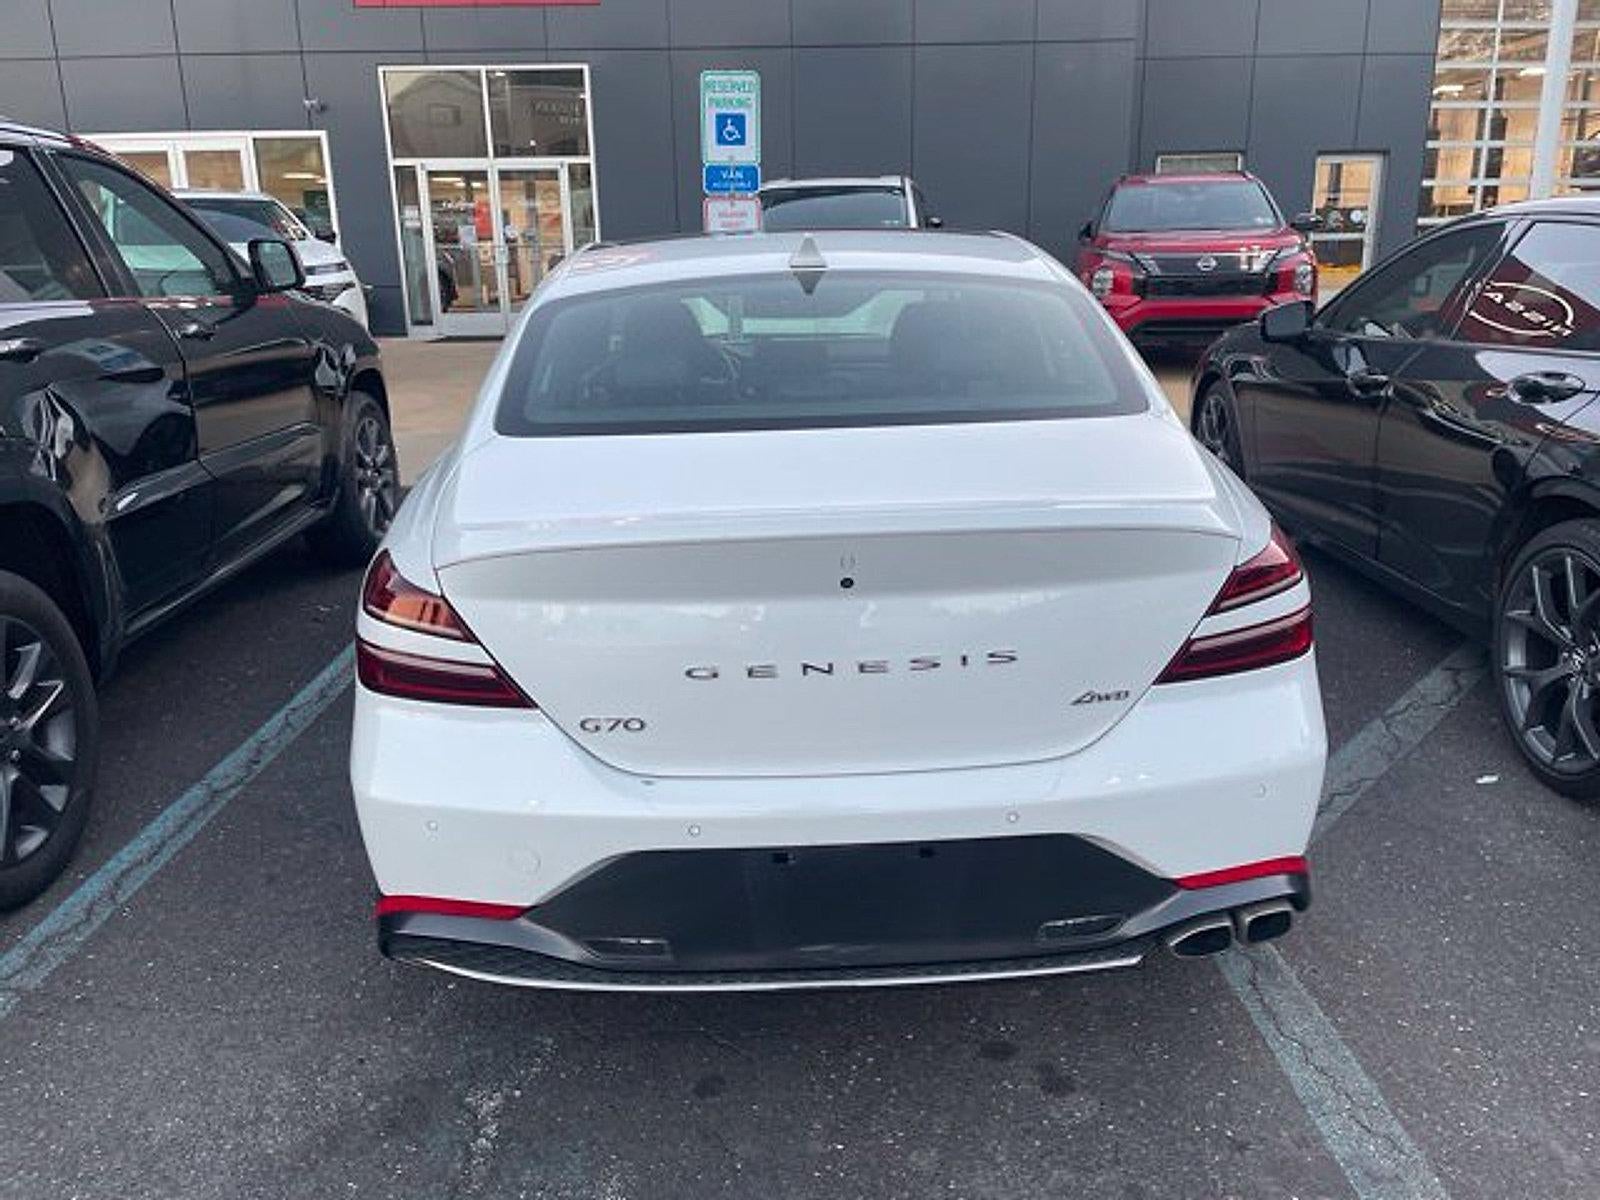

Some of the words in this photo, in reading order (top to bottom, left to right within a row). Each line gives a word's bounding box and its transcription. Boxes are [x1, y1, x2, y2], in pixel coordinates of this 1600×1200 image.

[720, 169, 744, 179] VAN
[685, 650, 1018, 680] GENESIS
[1070, 689, 1130, 706] AWD
[579, 717, 646, 733] G70
